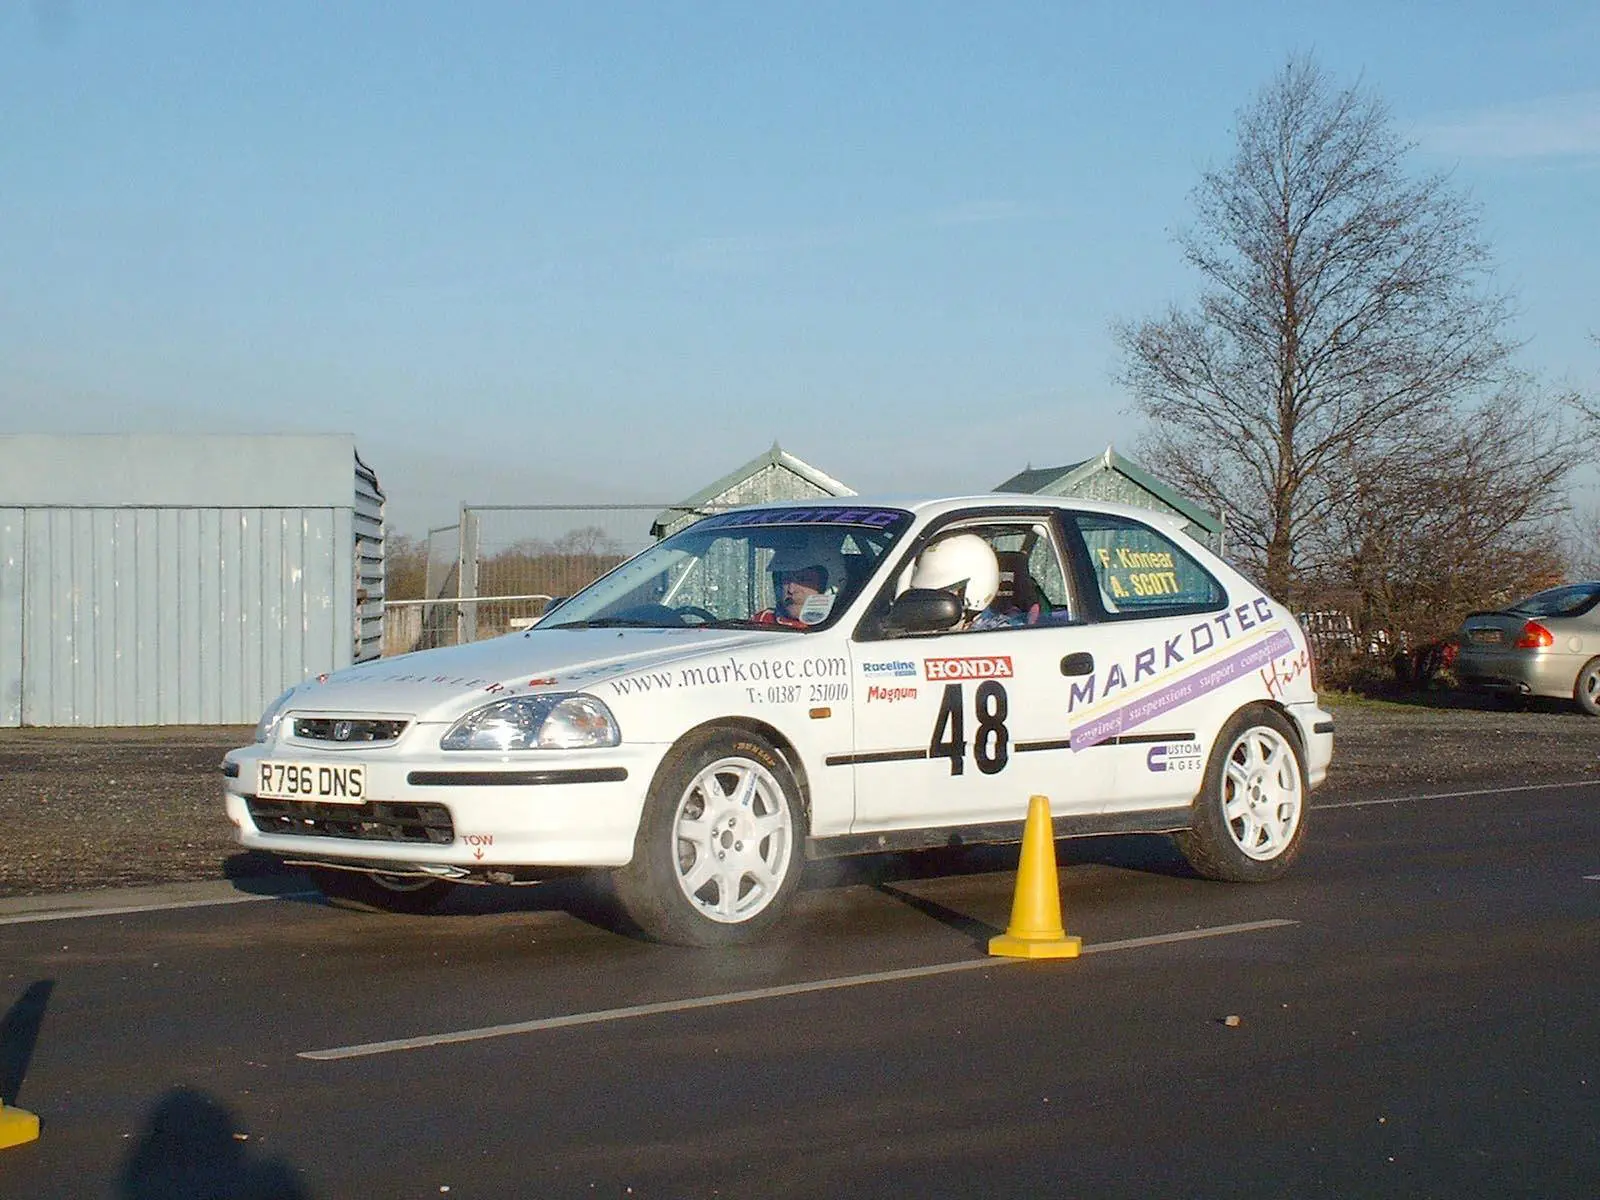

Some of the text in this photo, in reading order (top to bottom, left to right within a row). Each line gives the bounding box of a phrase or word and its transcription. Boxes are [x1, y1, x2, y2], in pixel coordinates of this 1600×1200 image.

[1116, 548, 1174, 568] Kinnear
[1110, 572, 1179, 598] A. SCOTT
[863, 661, 916, 672] Raceline
[1068, 597, 1274, 713] MARKOTEC
[610, 657, 847, 696] www.markotec.com
[926, 657, 1012, 679] HONDA
[746, 684, 848, 704] T: 01387 251010
[867, 686, 917, 703] Magnum
[1129, 684, 1193, 720] suspensions
[1200, 663, 1235, 688] support
[929, 680, 1010, 776] 48
[261, 764, 362, 797] R796 DNS
[460, 835, 493, 846] TOW
